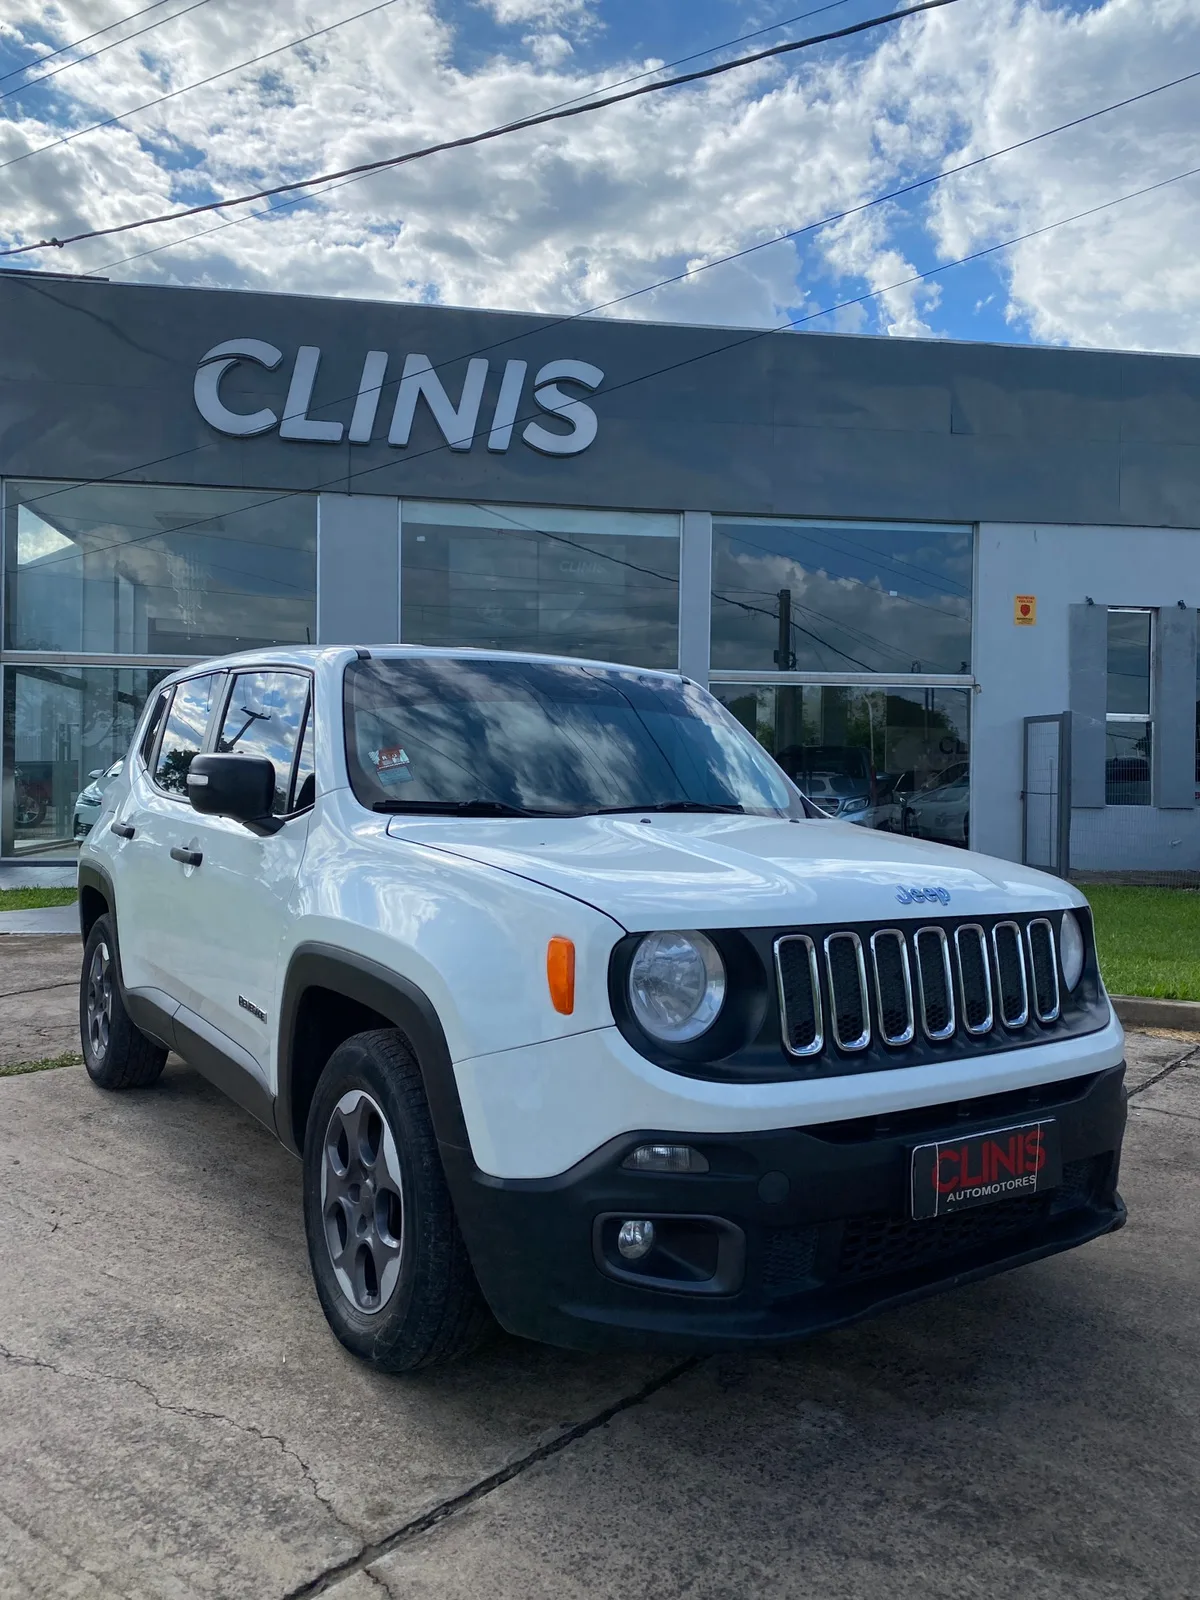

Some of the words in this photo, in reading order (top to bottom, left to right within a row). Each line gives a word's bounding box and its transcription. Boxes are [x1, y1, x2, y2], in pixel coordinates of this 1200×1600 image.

[193, 337, 606, 457] CLINIS
[895, 885, 951, 906] Jeep
[932, 1130, 1046, 1193] CLINIS
[947, 1174, 1037, 1202] AUTOMOTORES
